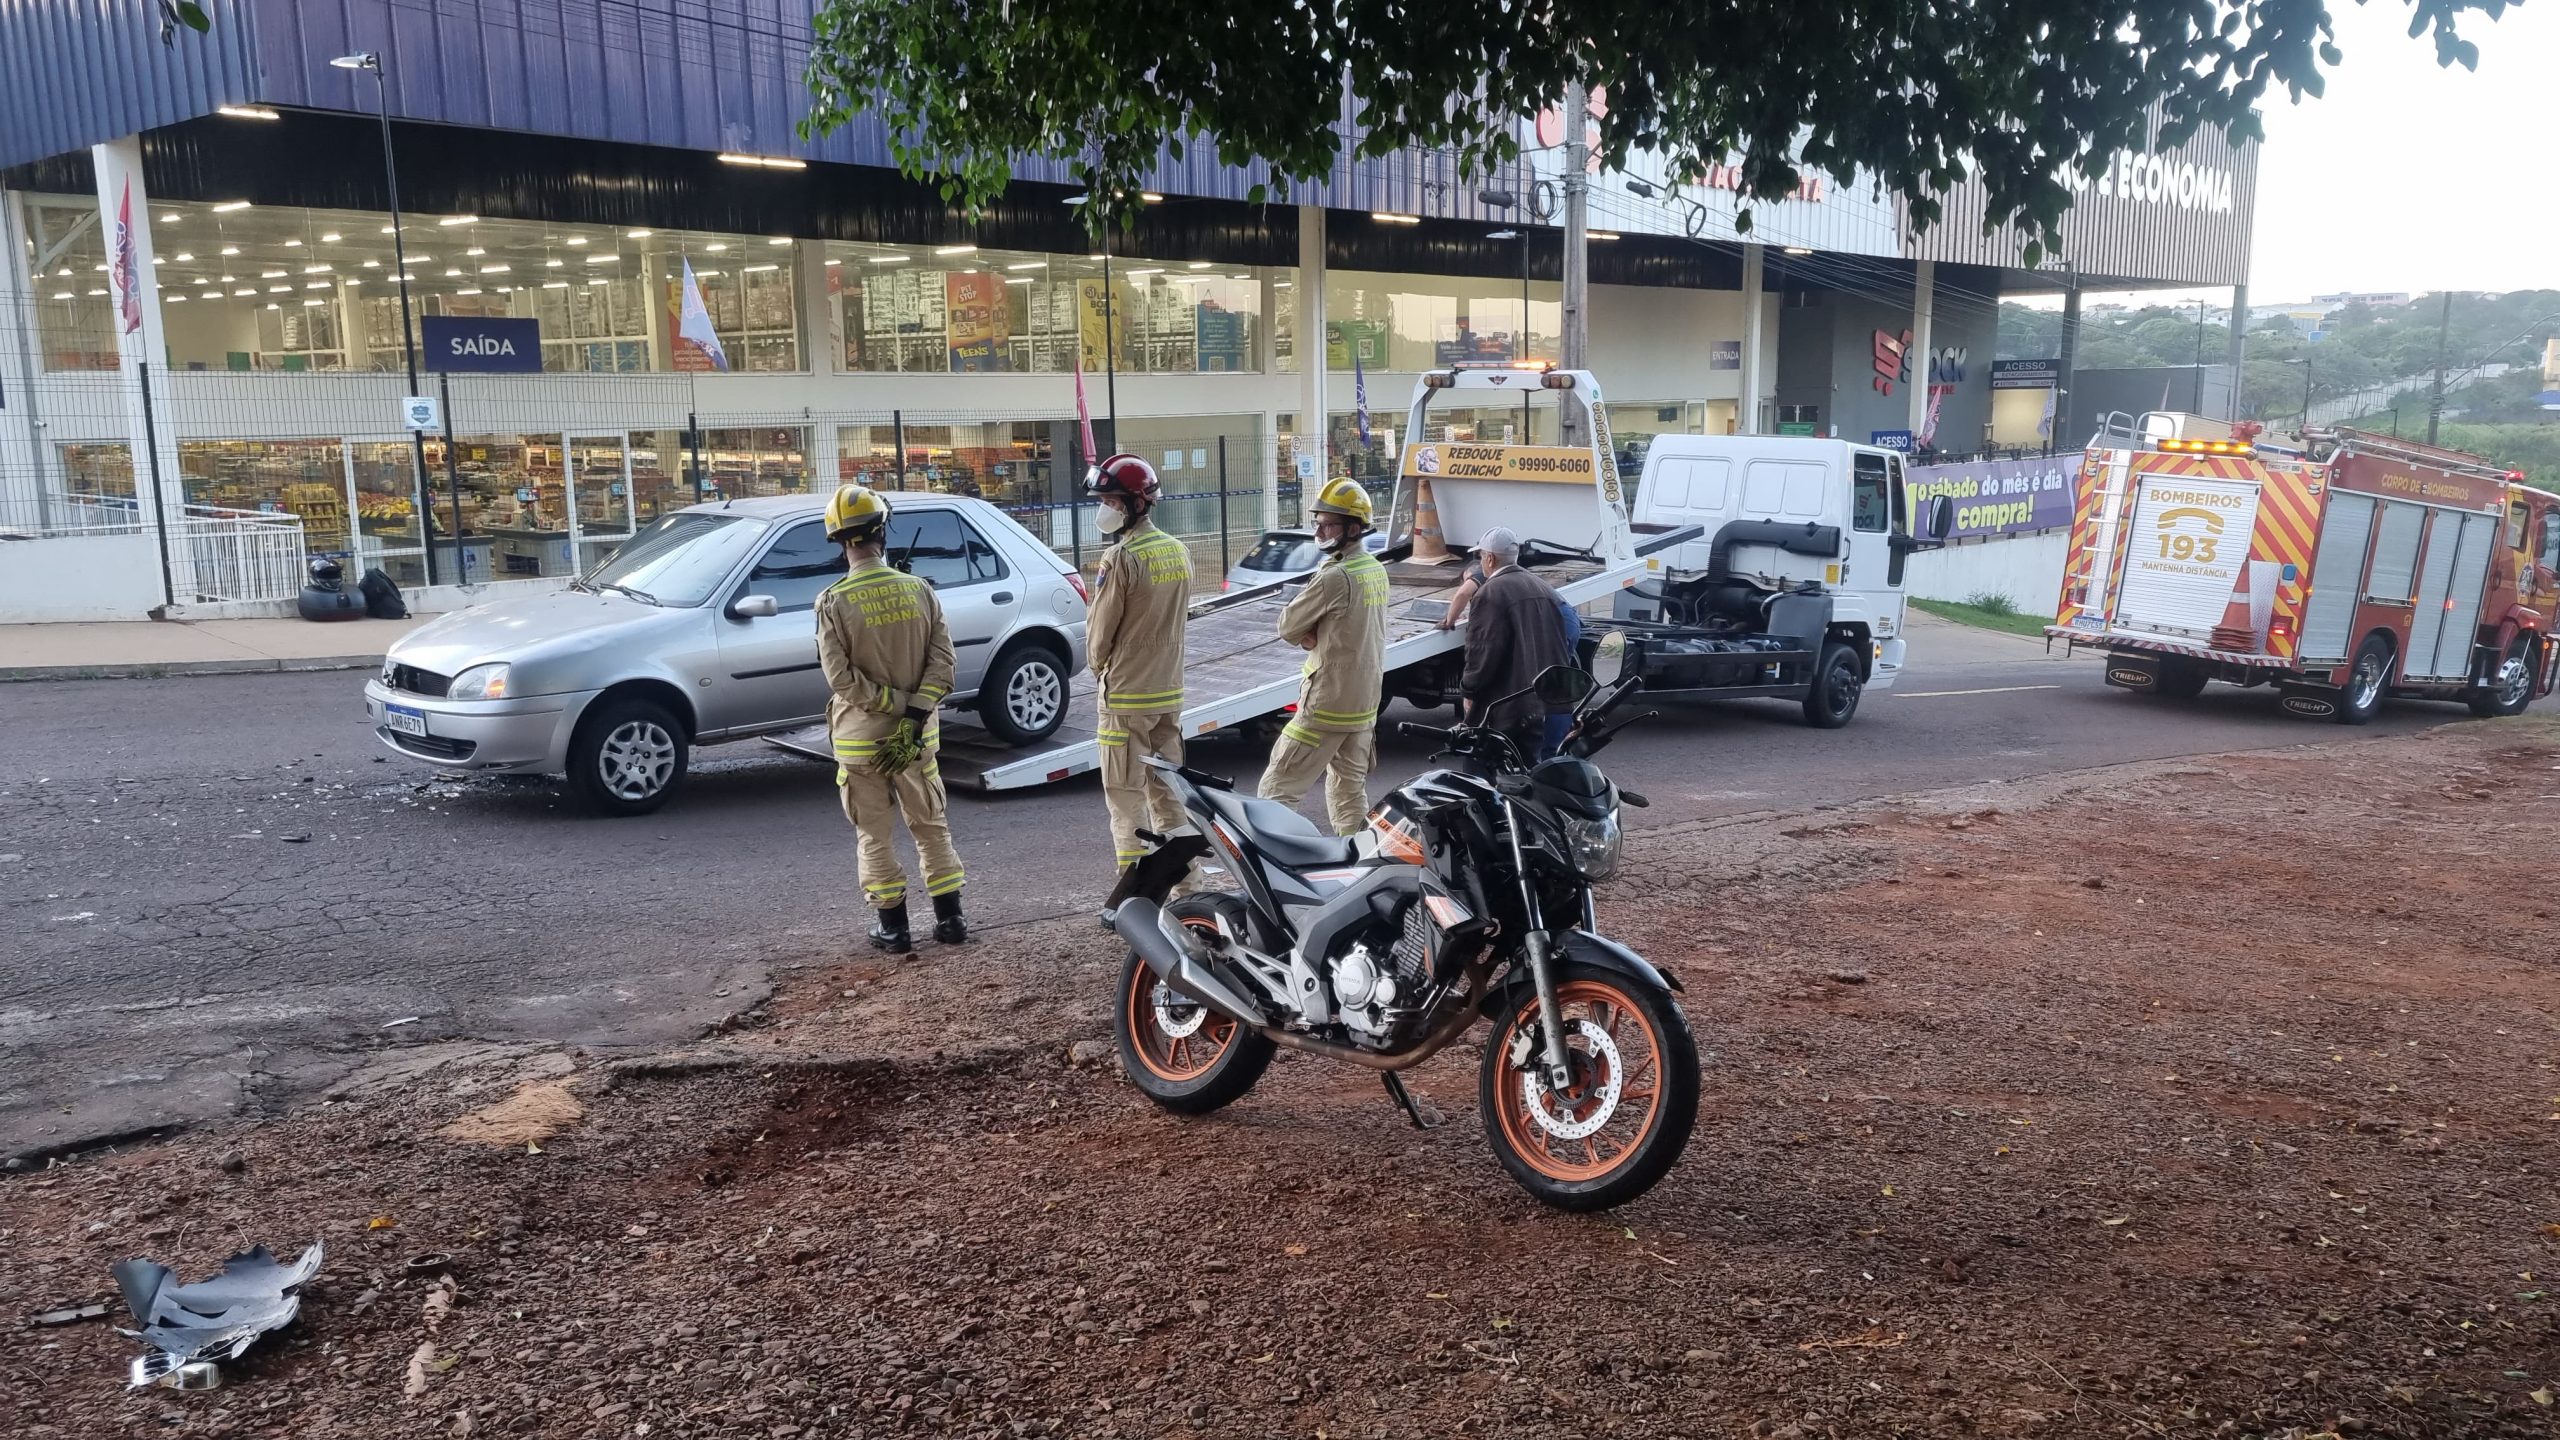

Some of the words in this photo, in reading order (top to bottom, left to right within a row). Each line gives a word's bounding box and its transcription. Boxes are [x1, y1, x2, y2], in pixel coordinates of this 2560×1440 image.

[2117, 149, 2232, 216] ECONOMIA
[1097, 292, 1117, 300] UA
[450, 333, 516, 356] SAÍDA
[957, 345, 989, 359] TEENS
[1712, 351, 1739, 360] ENTRADA
[1902, 347, 1967, 382] SOCK
[2004, 361, 2047, 371] ACESSO
[1875, 436, 1908, 448] ACESSO
[1448, 447, 1504, 461] REBOQUE
[1448, 463, 1503, 477] GUINCHO
[1519, 457, 1590, 473] 99990-6060
[1928, 476, 1979, 501] sábado
[1981, 475, 1999, 497] do
[2002, 471, 2029, 494] mês
[2032, 470, 2040, 491] é
[2043, 468, 2062, 490] dia
[2381, 473, 2408, 491] CORPO
[2409, 479, 2421, 493] DE
[2426, 483, 2470, 501] BOMBEIROS
[2150, 489, 2242, 509] BOMBEIROS
[1957, 494, 2034, 532] compra!
[2158, 533, 2218, 564] 193
[2141, 561, 2184, 574] MANTENHA
[846, 581, 921, 604] BOMBEIRO
[860, 594, 919, 614] MILITAR
[389, 714, 422, 732] ANR6E79
